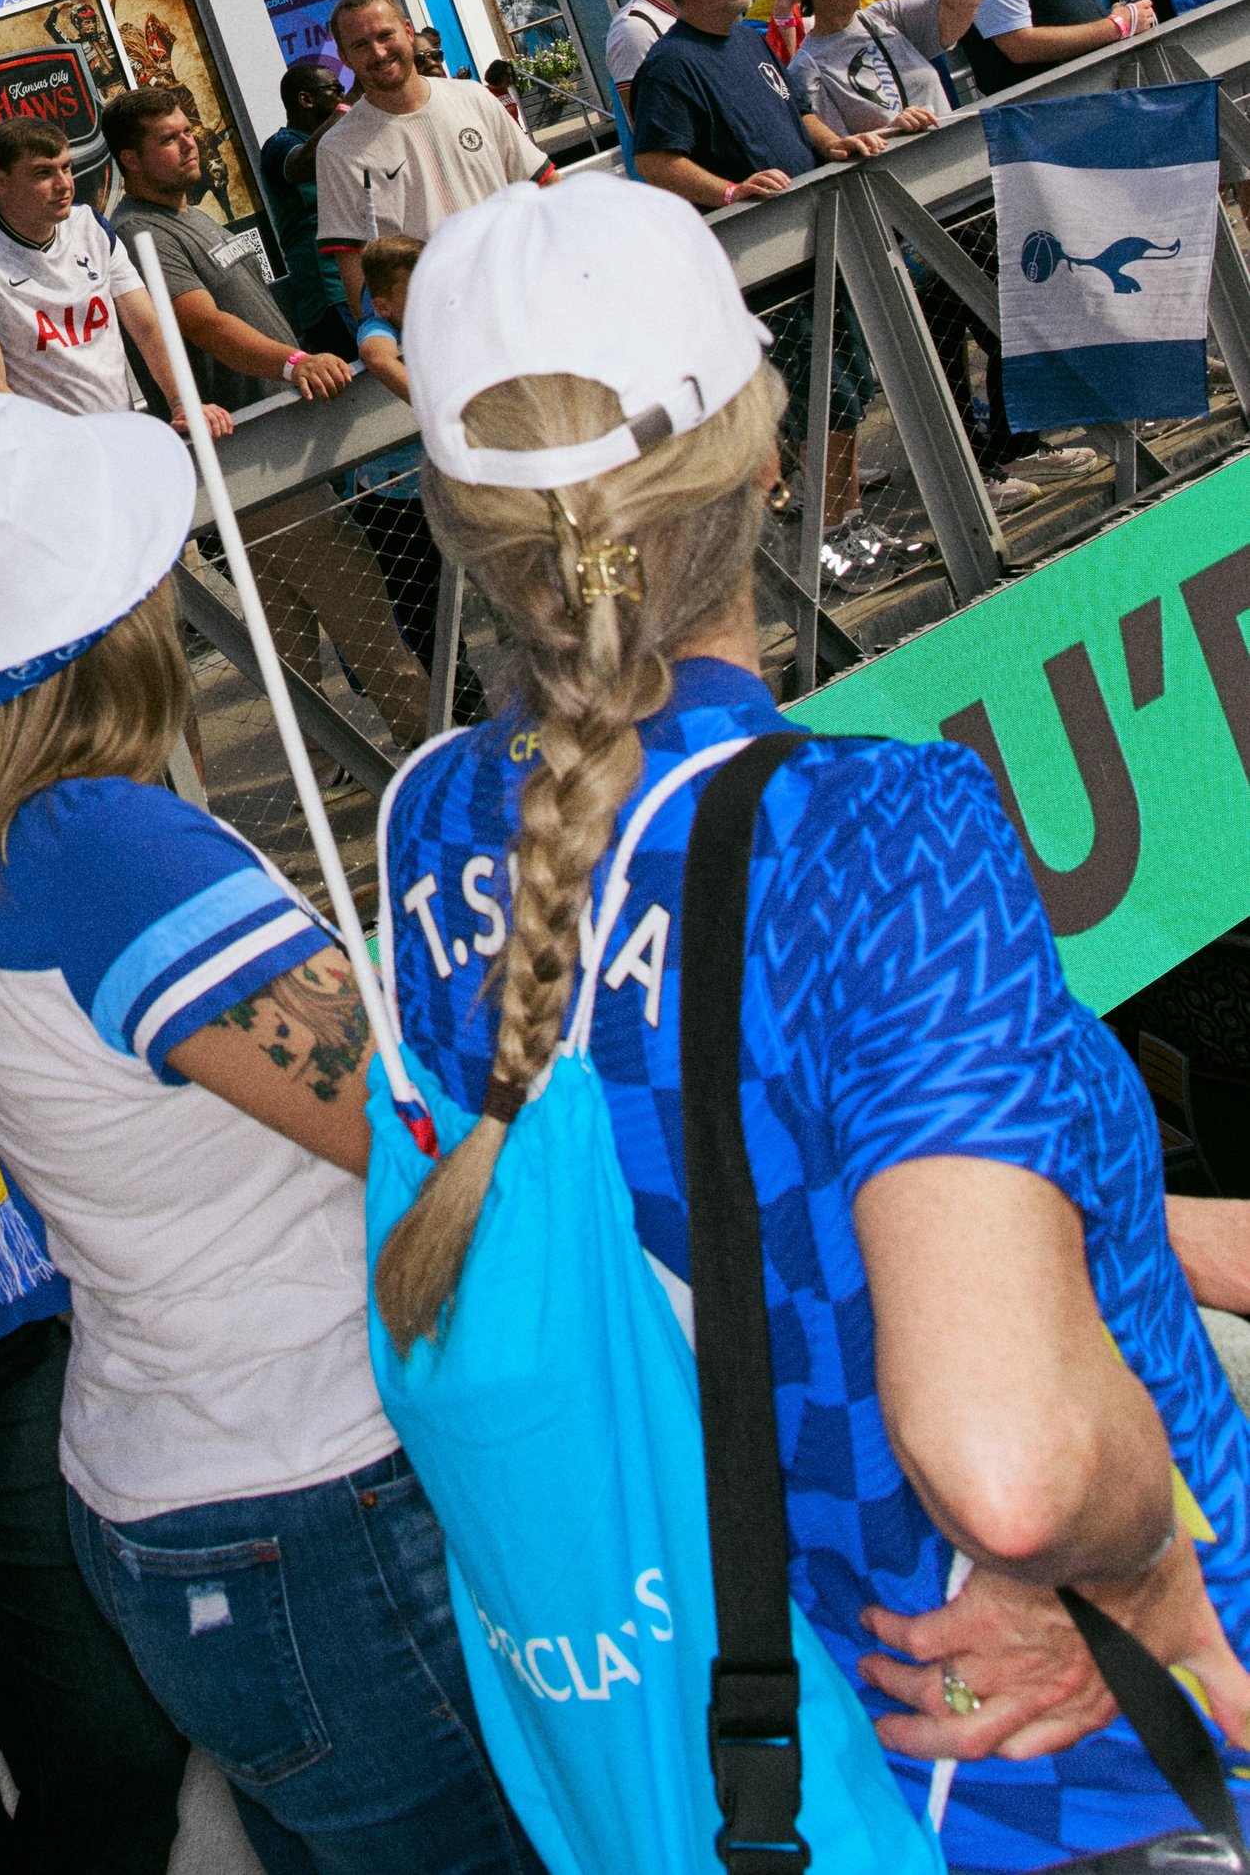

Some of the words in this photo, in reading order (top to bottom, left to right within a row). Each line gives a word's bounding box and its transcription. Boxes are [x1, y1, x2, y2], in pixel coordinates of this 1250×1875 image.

[8, 78, 49, 101] Kansas
[49, 69, 69, 88] City
[36, 296, 109, 352] AIA
